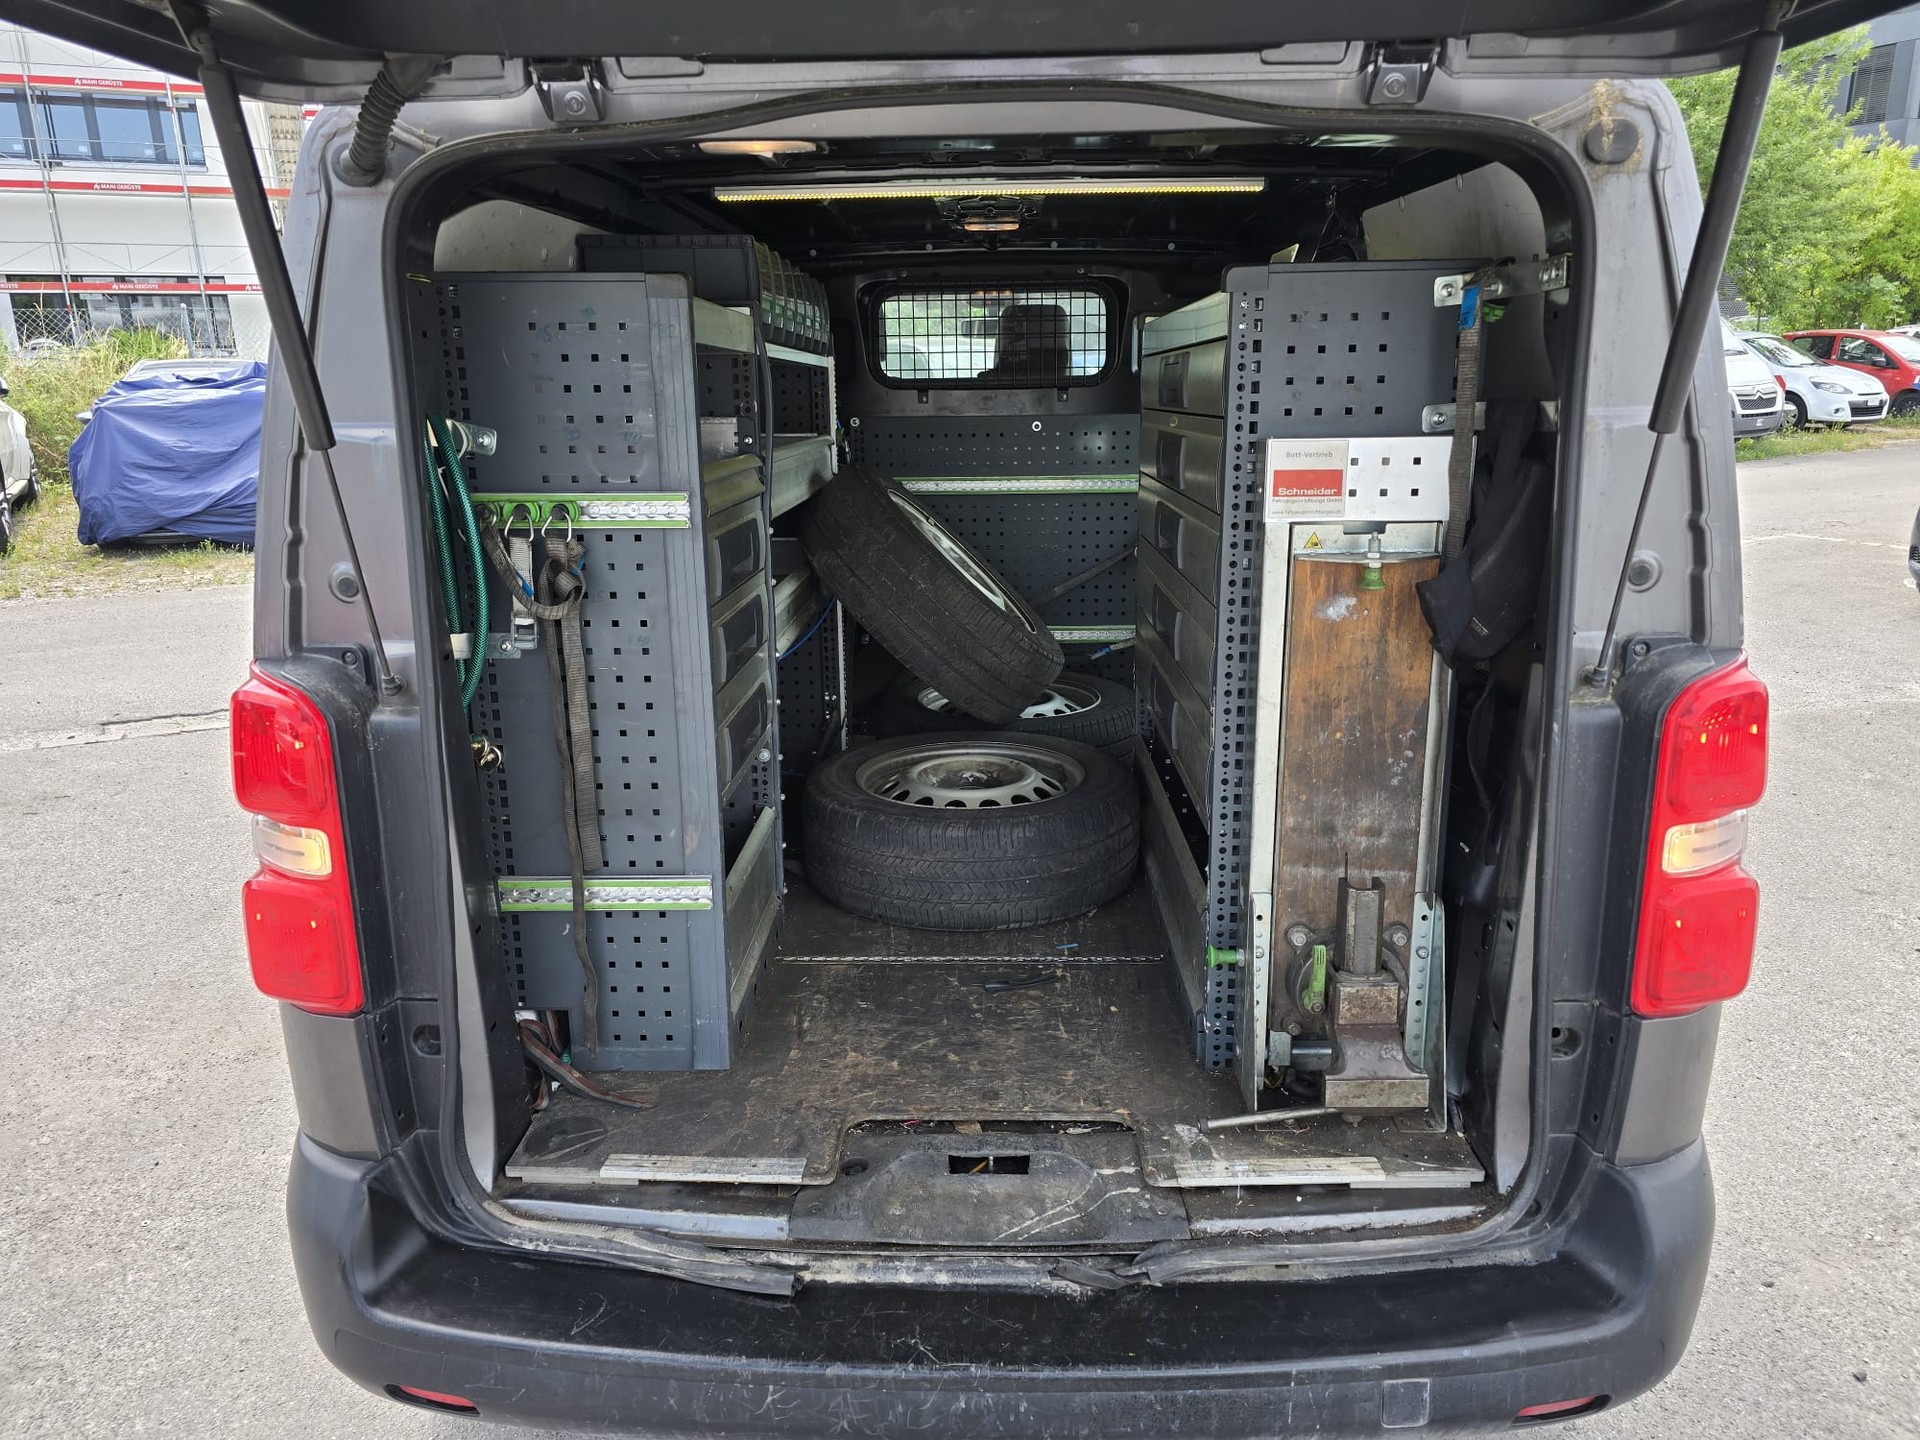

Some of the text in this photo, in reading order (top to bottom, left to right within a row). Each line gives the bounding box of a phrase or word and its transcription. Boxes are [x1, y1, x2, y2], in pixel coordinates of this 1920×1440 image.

[81, 78, 124, 87] MANI GERÜSTE
[100, 182, 142, 191] MANI GERÜSTE
[1285, 451, 1334, 459] Bott-Vertrieb
[1277, 487, 1338, 496] Schneider
